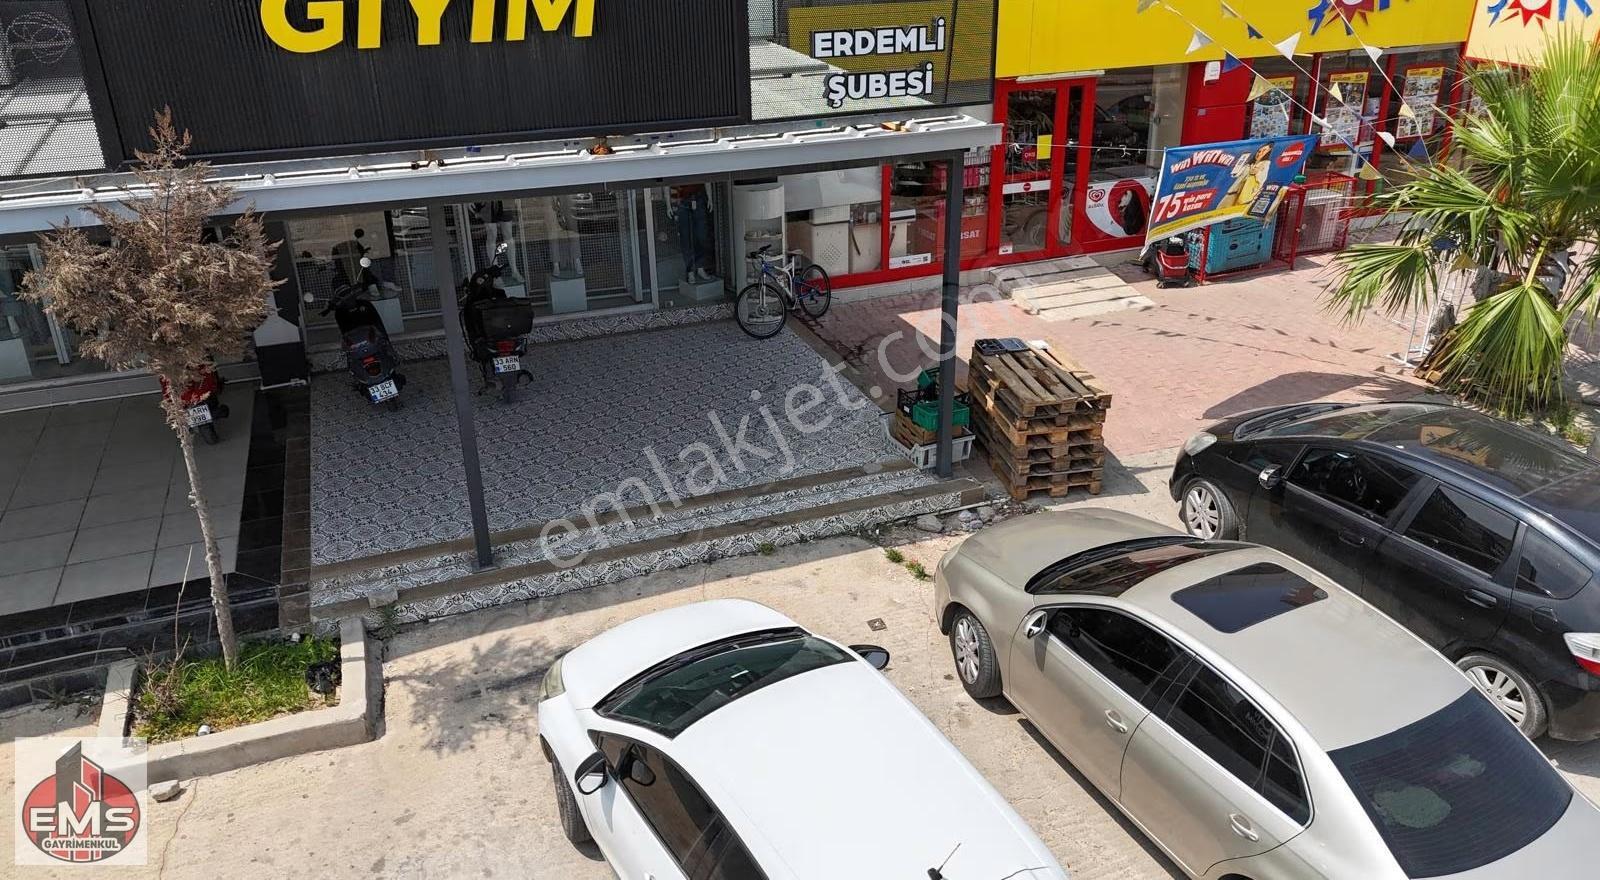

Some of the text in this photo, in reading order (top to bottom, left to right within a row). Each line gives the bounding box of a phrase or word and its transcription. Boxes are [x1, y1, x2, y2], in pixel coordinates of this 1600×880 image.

[813, 17, 946, 58] ERDEMLİ
[827, 61, 934, 108] ŞUBESİ
[1155, 191, 1186, 223] 75
[503, 363, 517, 371] 560
[505, 356, 519, 364] ARN
